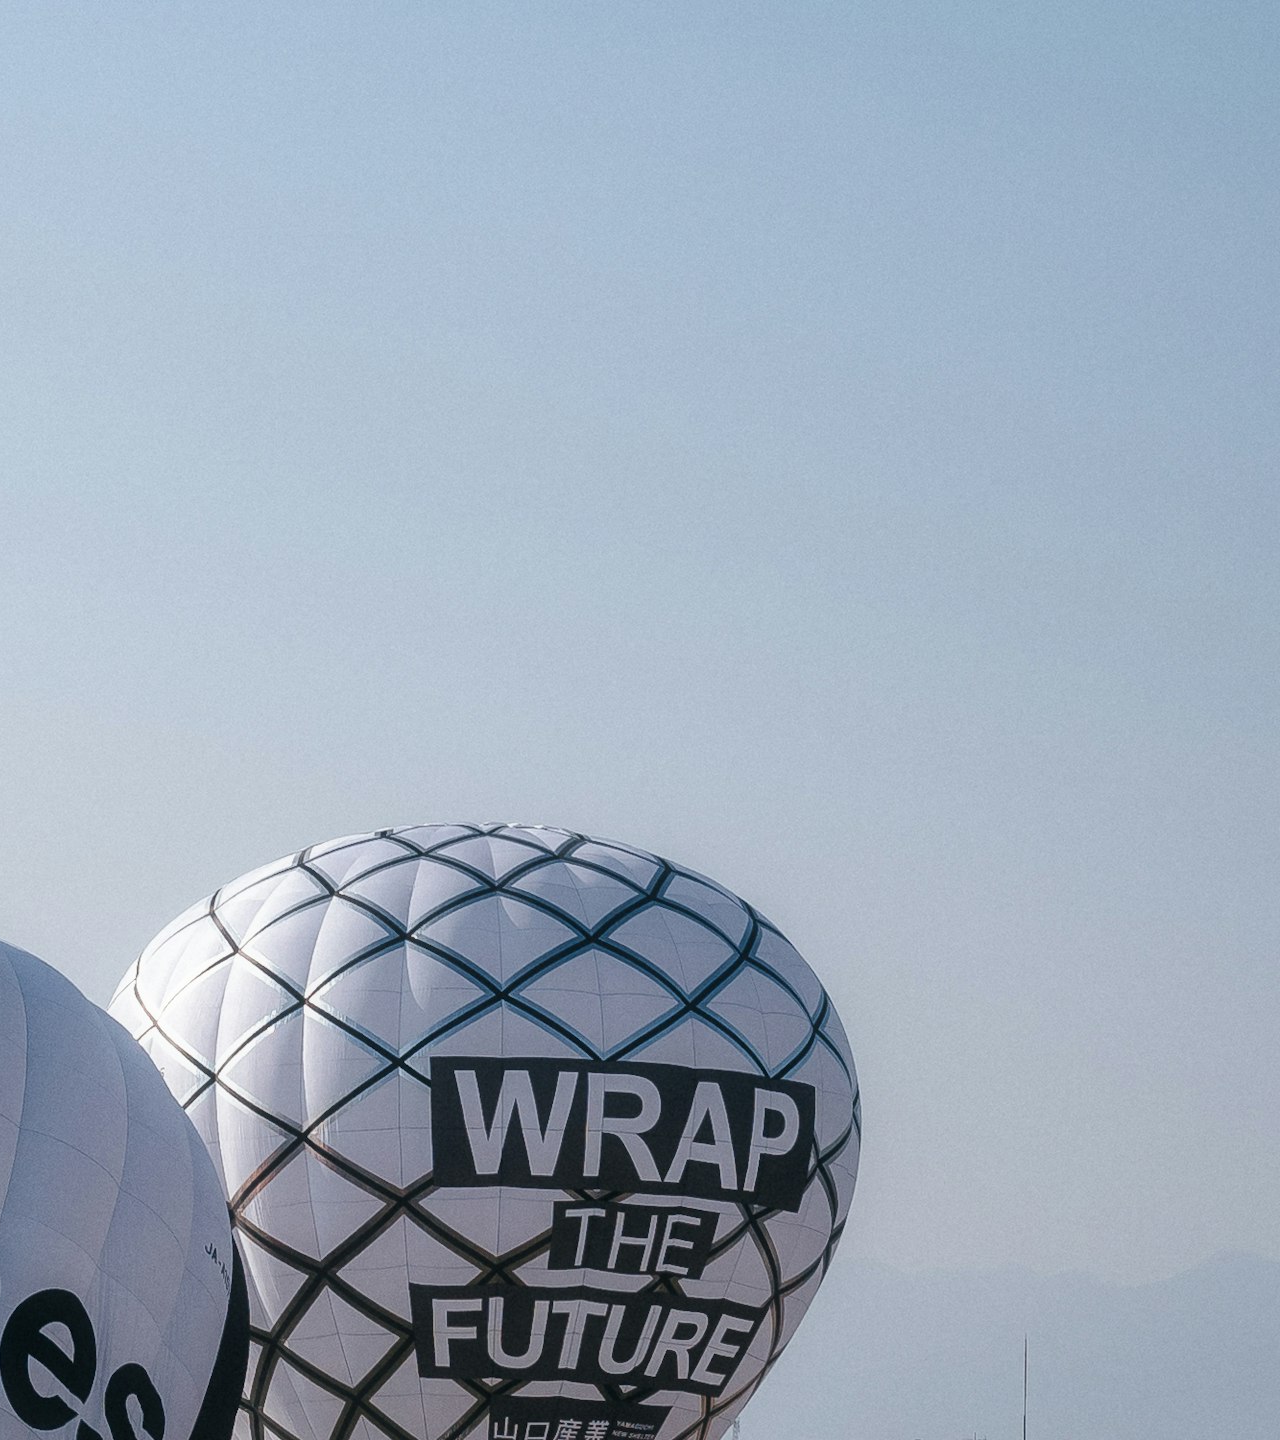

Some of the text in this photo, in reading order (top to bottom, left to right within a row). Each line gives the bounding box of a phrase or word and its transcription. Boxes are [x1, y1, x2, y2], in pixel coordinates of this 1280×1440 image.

[454, 1069, 800, 1193] WRAP
[564, 1208, 703, 1278] THE
[431, 1294, 759, 1388] FUTURE
